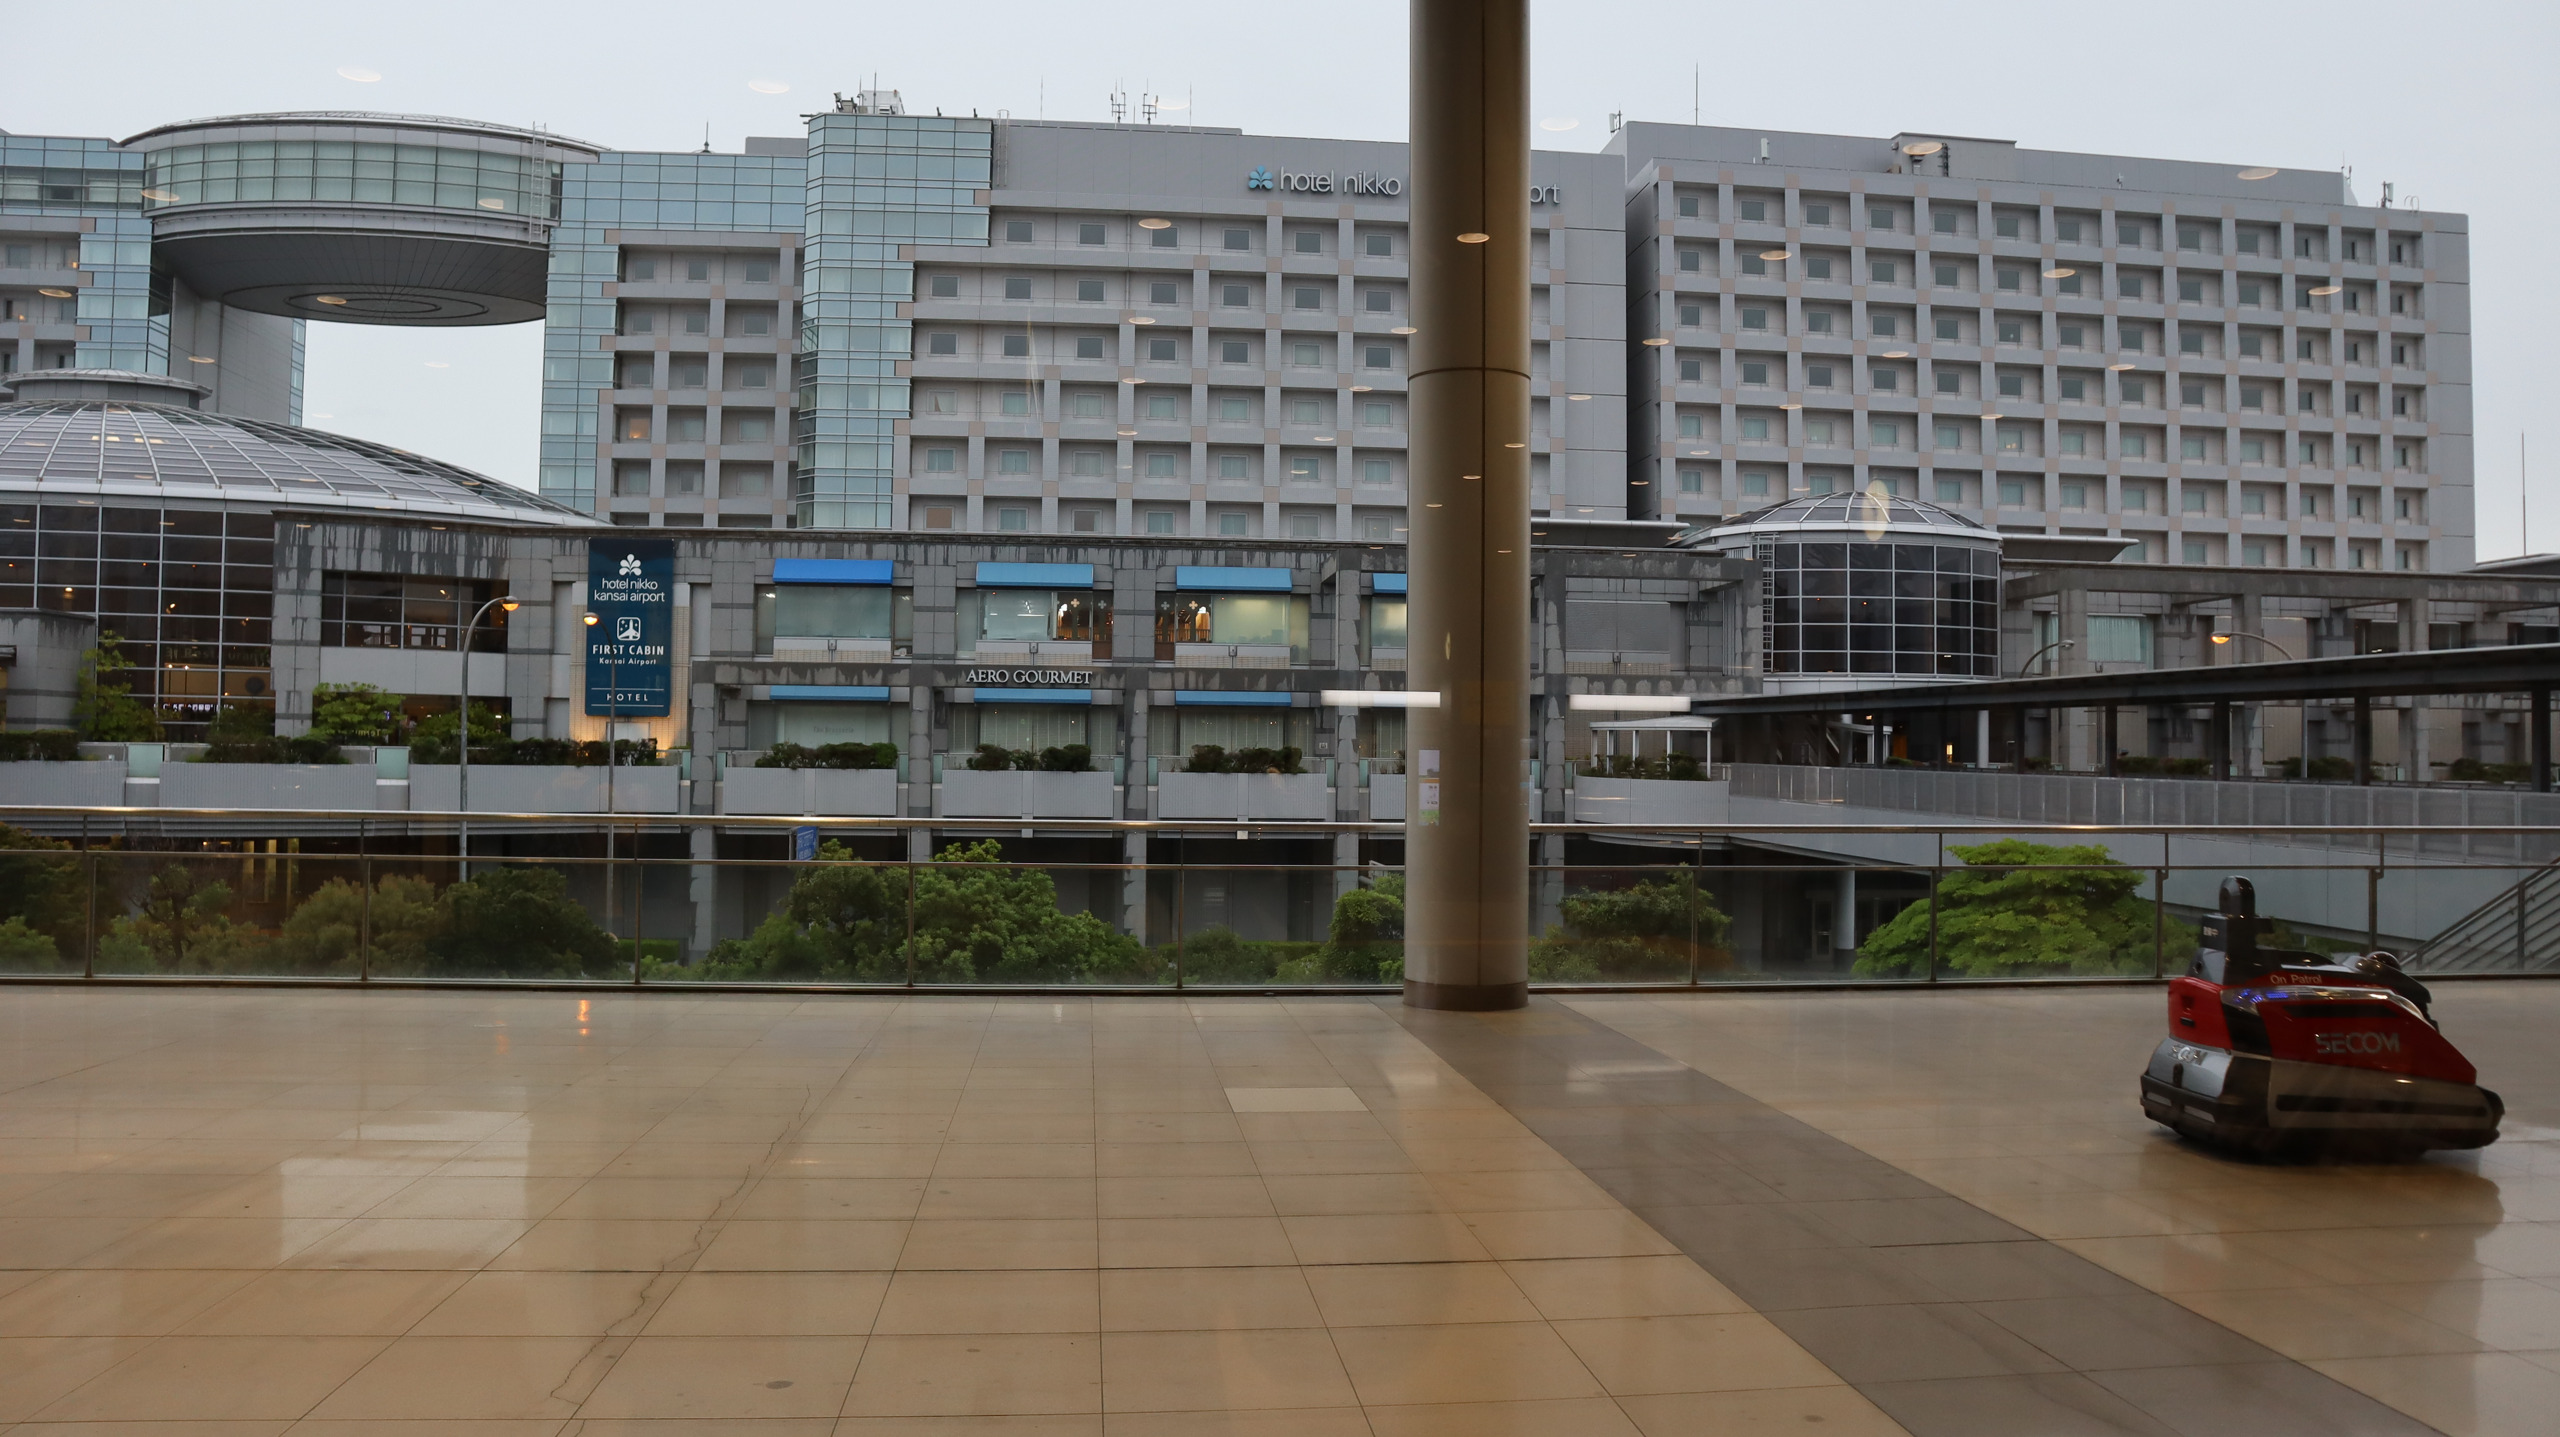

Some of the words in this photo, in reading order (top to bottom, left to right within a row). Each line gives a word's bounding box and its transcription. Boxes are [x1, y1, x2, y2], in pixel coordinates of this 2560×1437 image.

[1280, 166, 1335, 193] hotel
[1344, 170, 1402, 196] nikko
[601, 577, 629, 590] hotel
[630, 577, 659, 590] nikko
[594, 589, 629, 601] kansai
[630, 589, 665, 604] airport
[592, 644, 625, 655] FIRST
[629, 645, 664, 656] CABIN
[628, 658, 657, 666] Airport
[966, 669, 1009, 684] AERO
[1013, 670, 1093, 685] GOURMET
[606, 693, 648, 702] HOTEL
[2270, 974, 2287, 985] On
[2292, 974, 2323, 985] Patrol
[2316, 1031, 2401, 1055] SECOM
